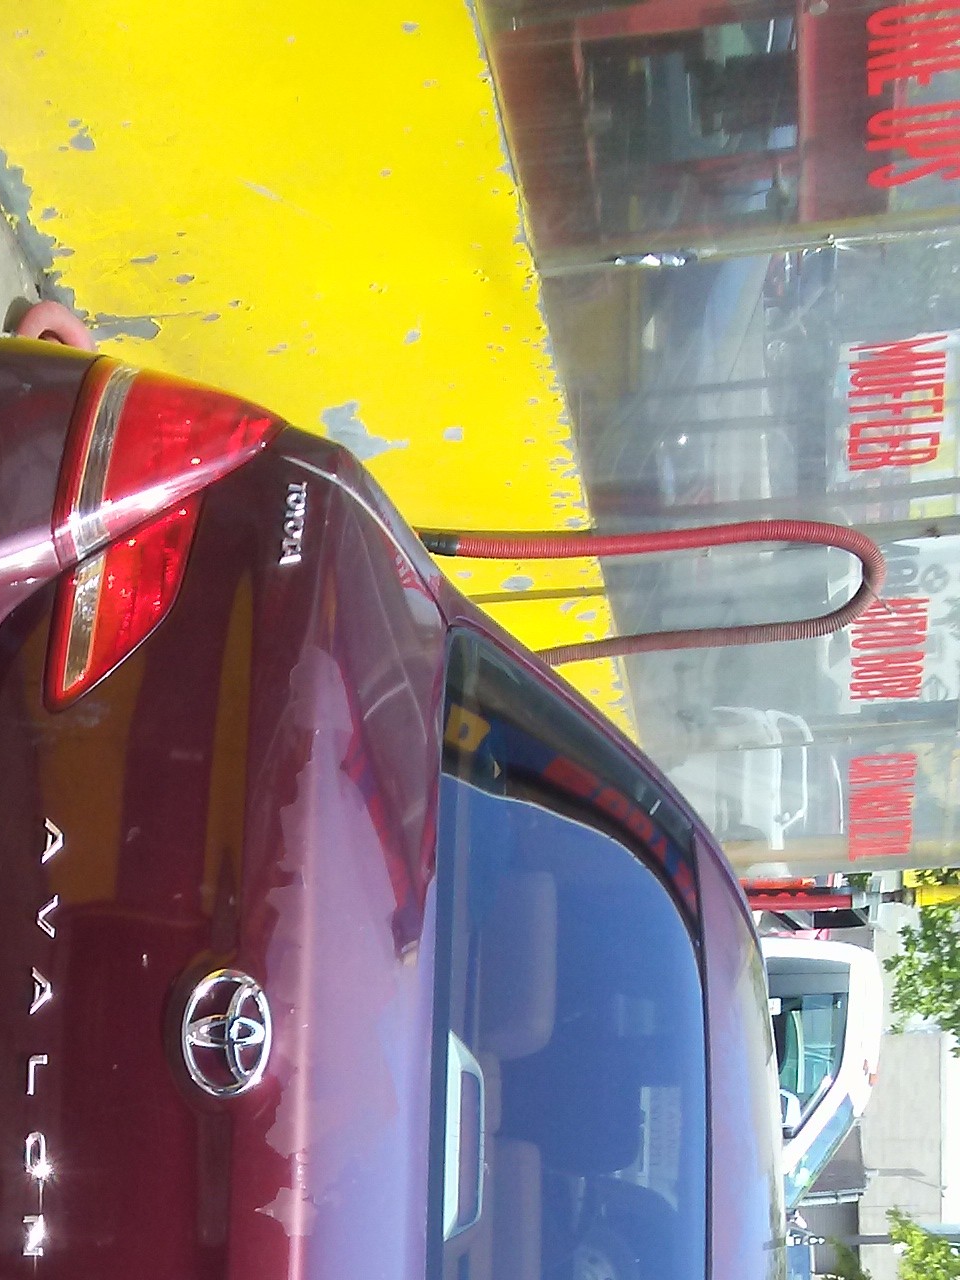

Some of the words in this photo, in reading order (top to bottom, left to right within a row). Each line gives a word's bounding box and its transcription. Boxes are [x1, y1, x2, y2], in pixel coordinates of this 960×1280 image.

[866, 0, 960, 97] UNE
[866, 100, 960, 190] UPS
[848, 335, 948, 472] MUFFLER
[279, 480, 308, 565] TOYOTA
[850, 597, 930, 651] AUTO
[849, 652, 926, 701] BODY
[849, 753, 918, 785] CAR
[22, 817, 64, 1257] AVALON
